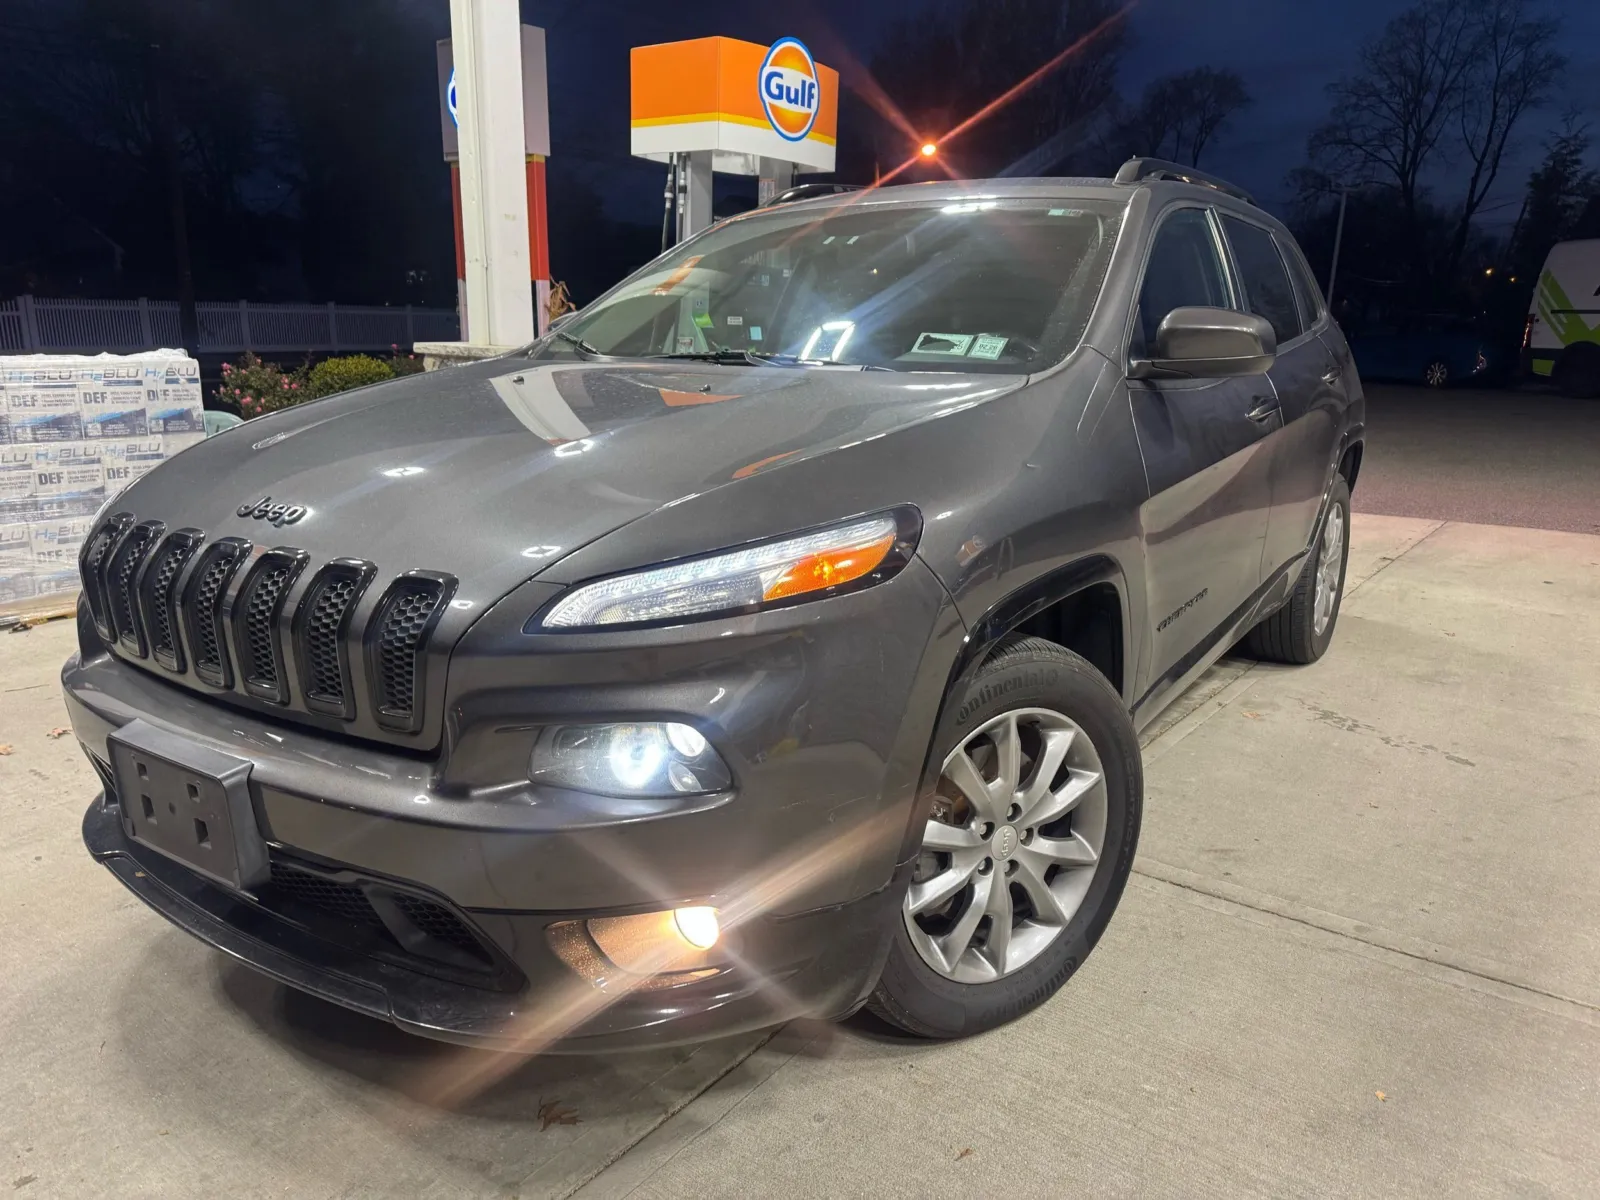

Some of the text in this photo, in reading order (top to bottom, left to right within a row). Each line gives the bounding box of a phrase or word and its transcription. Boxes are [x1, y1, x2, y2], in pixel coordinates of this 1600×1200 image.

[764, 71, 816, 109] Gulf
[11, 394, 38, 407] DEF
[83, 391, 108, 404] DEF
[36, 447, 97, 461] HBLU
[38, 471, 64, 485] DEF
[106, 466, 130, 480] DEF
[236, 496, 307, 528] Jeep
